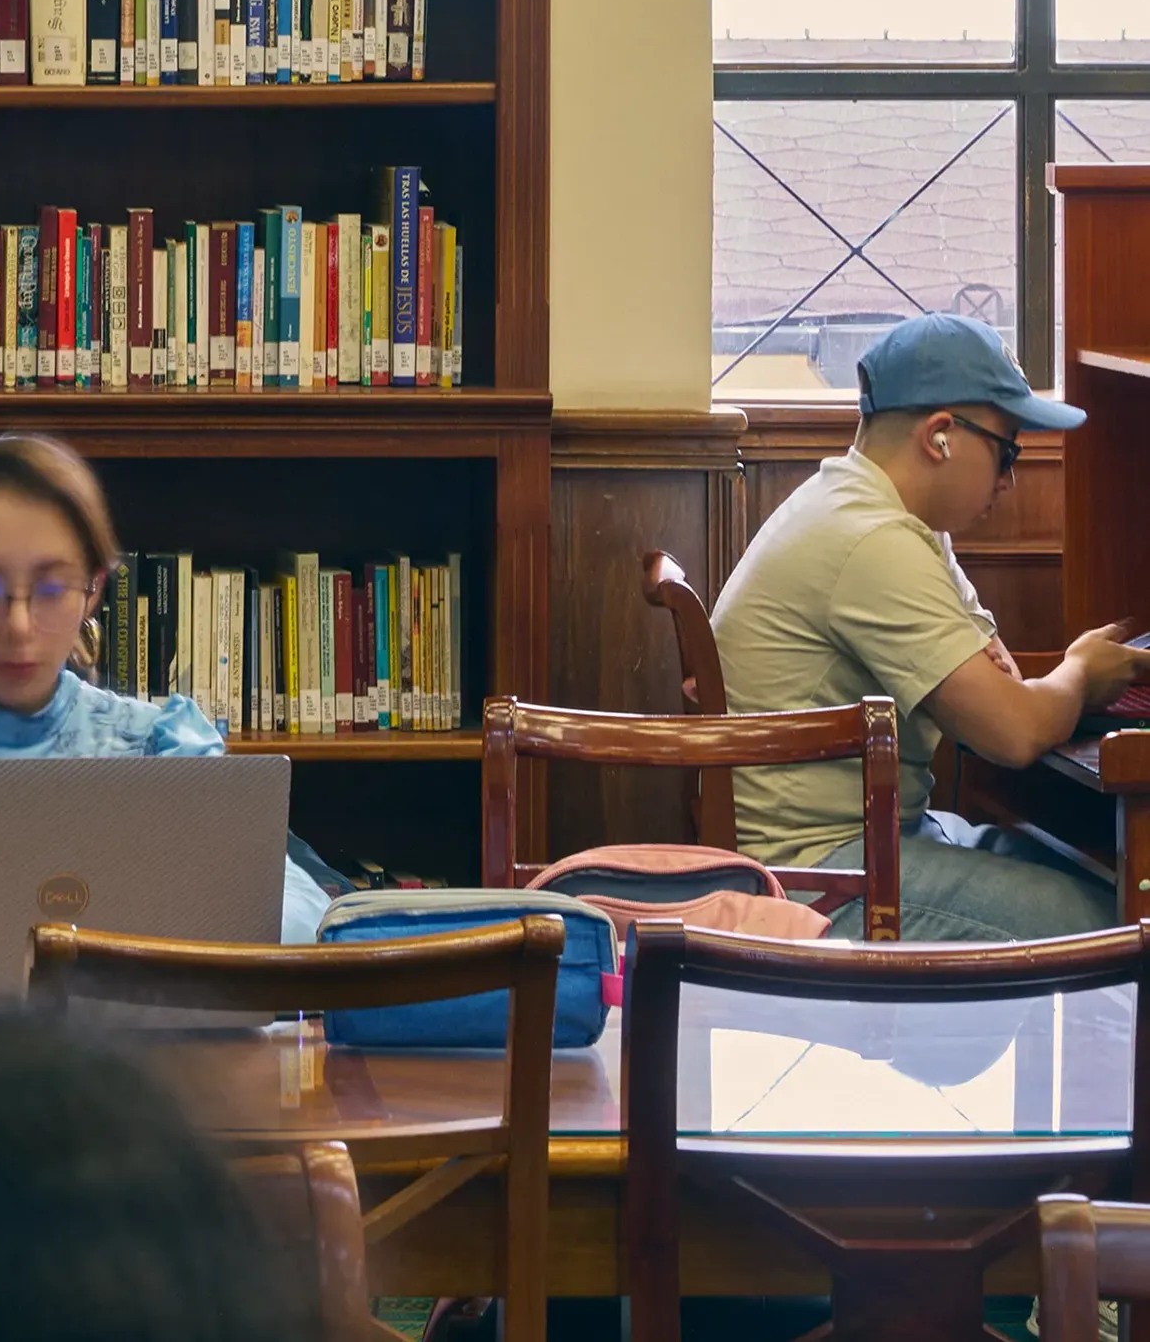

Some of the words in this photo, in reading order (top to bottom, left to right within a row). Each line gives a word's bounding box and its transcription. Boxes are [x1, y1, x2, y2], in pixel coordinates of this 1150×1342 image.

[248, 17, 261, 42] ISAAC
[330, 4, 340, 36] Nuevo
[402, 173, 411, 199] TRAS
[402, 200, 411, 218] LAS
[20, 234, 38, 282] Growing
[401, 224, 411, 267] HUELLAS
[287, 228, 297, 294] JESUCRISTO
[401, 269, 410, 284] DE
[396, 285, 415, 334] JESÚS
[118, 577, 128, 597] THE
[118, 600, 128, 626] JESUS
[117, 628, 128, 690] CONSPIRACY
[232, 632, 240, 680] ANTICRISTO
[45, 890, 81, 904] DELL
